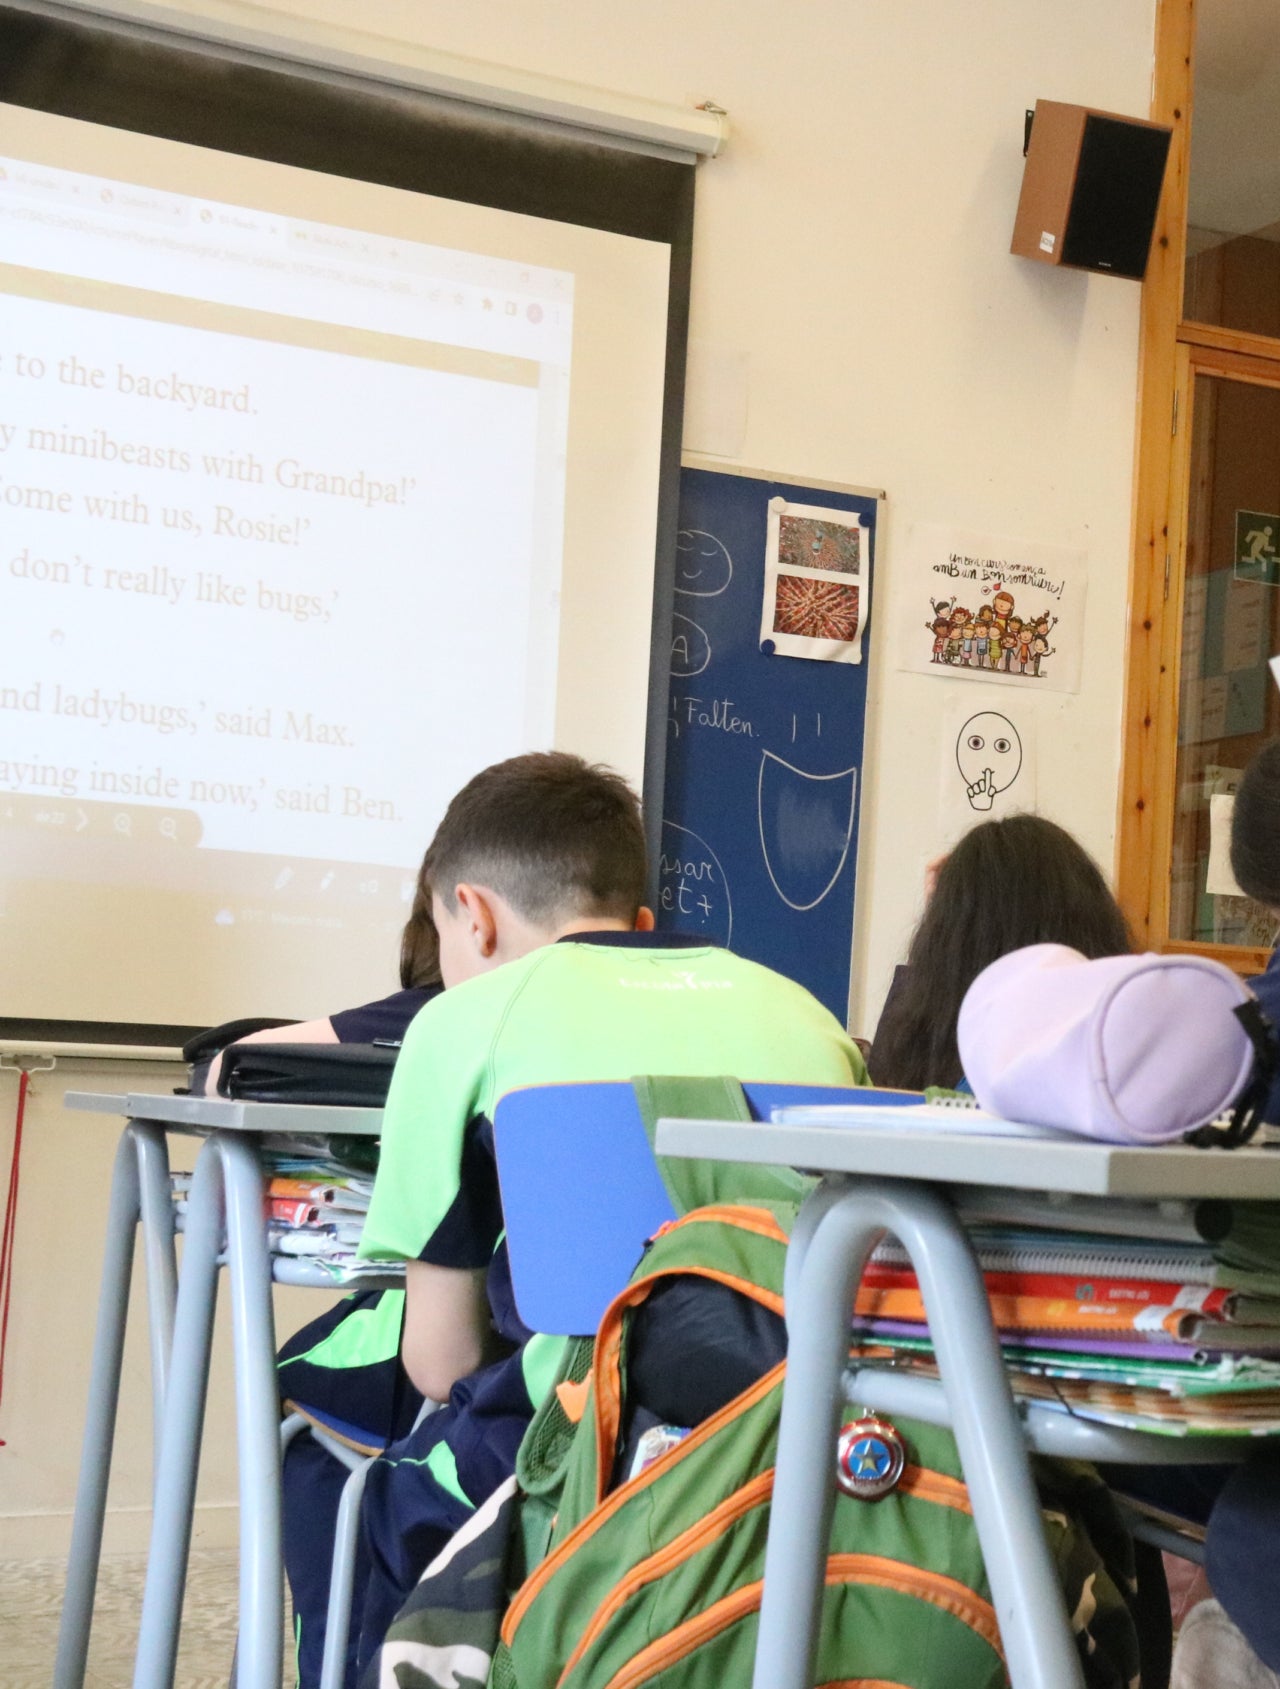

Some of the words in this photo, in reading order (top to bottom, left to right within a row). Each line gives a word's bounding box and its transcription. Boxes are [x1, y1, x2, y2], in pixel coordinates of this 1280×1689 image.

[15, 352, 46, 379] to
[57, 355, 105, 389] the
[116, 363, 259, 416] backyard.
[26, 423, 192, 473] minibeasts
[202, 450, 264, 484] with
[0, 475, 72, 513] ome
[83, 490, 149, 525] with
[161, 506, 202, 536] us,
[103, 565, 188, 606] really
[195, 571, 246, 607] like
[215, 706, 272, 738] said
[282, 710, 356, 747] Max.
[89, 761, 180, 799] inside
[275, 781, 331, 814] said
[341, 785, 404, 822] Ben.
